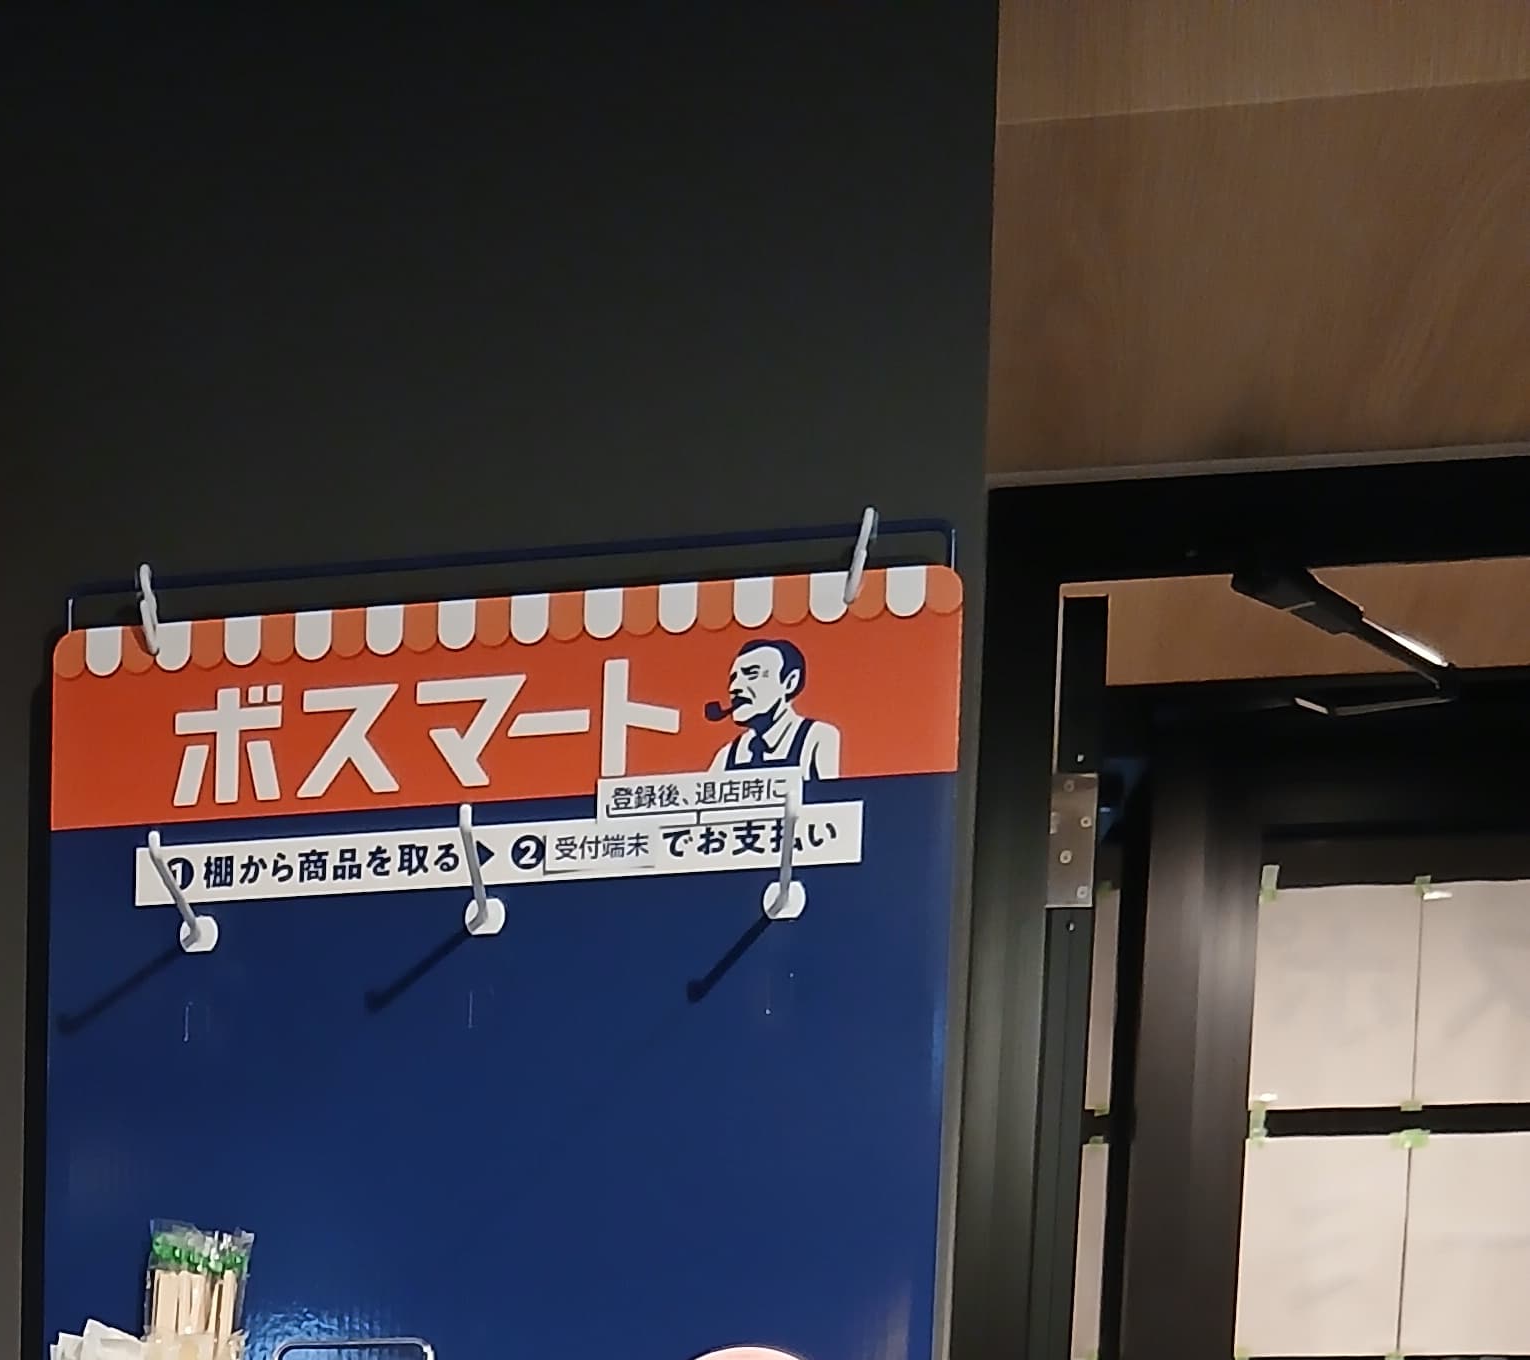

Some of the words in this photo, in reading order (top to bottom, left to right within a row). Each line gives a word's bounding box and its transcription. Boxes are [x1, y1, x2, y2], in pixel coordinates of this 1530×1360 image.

[171, 658, 679, 807] ボスマート
[610, 778, 789, 811] 登録後、退店時に
[203, 843, 460, 889] 棚から商品を取る
[554, 832, 650, 861] 受付端末
